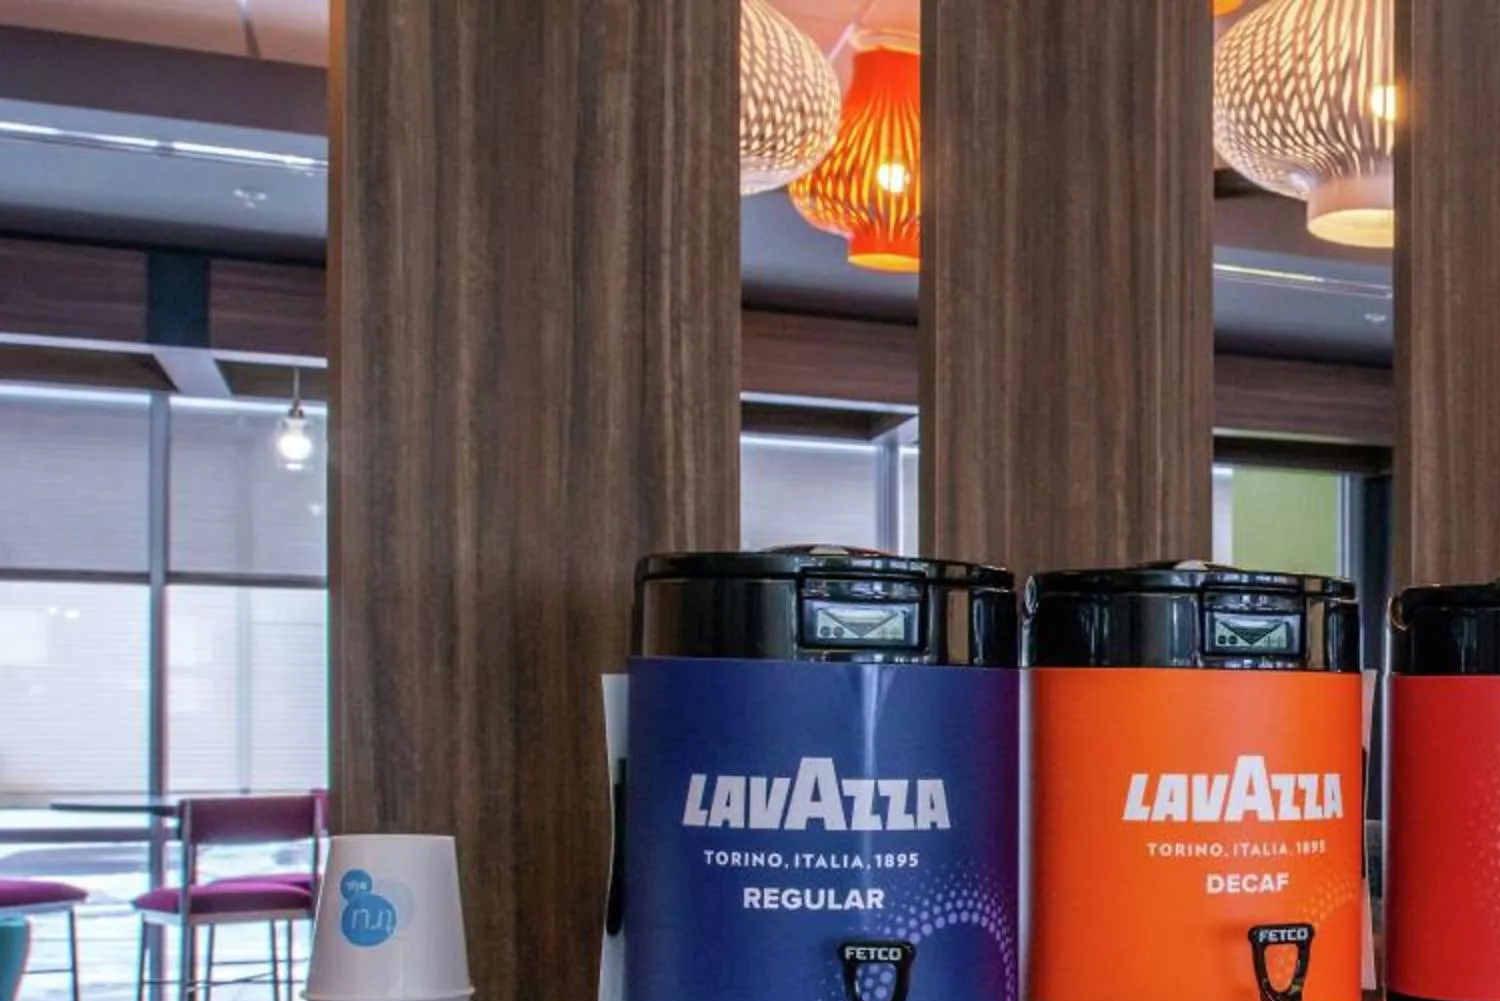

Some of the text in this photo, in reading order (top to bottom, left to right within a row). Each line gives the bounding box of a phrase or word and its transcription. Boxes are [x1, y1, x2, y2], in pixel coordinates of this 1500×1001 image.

[682, 757, 951, 831] LAVAZZA
[1122, 755, 1344, 822] LAVAZZA
[1296, 839, 1327, 856] 1895
[874, 853, 919, 868] 1895
[1206, 872, 1290, 894] DECAF
[743, 887, 886, 910] REGULAR
[1258, 928, 1309, 943] FETCO
[845, 946, 903, 961] FETCO
